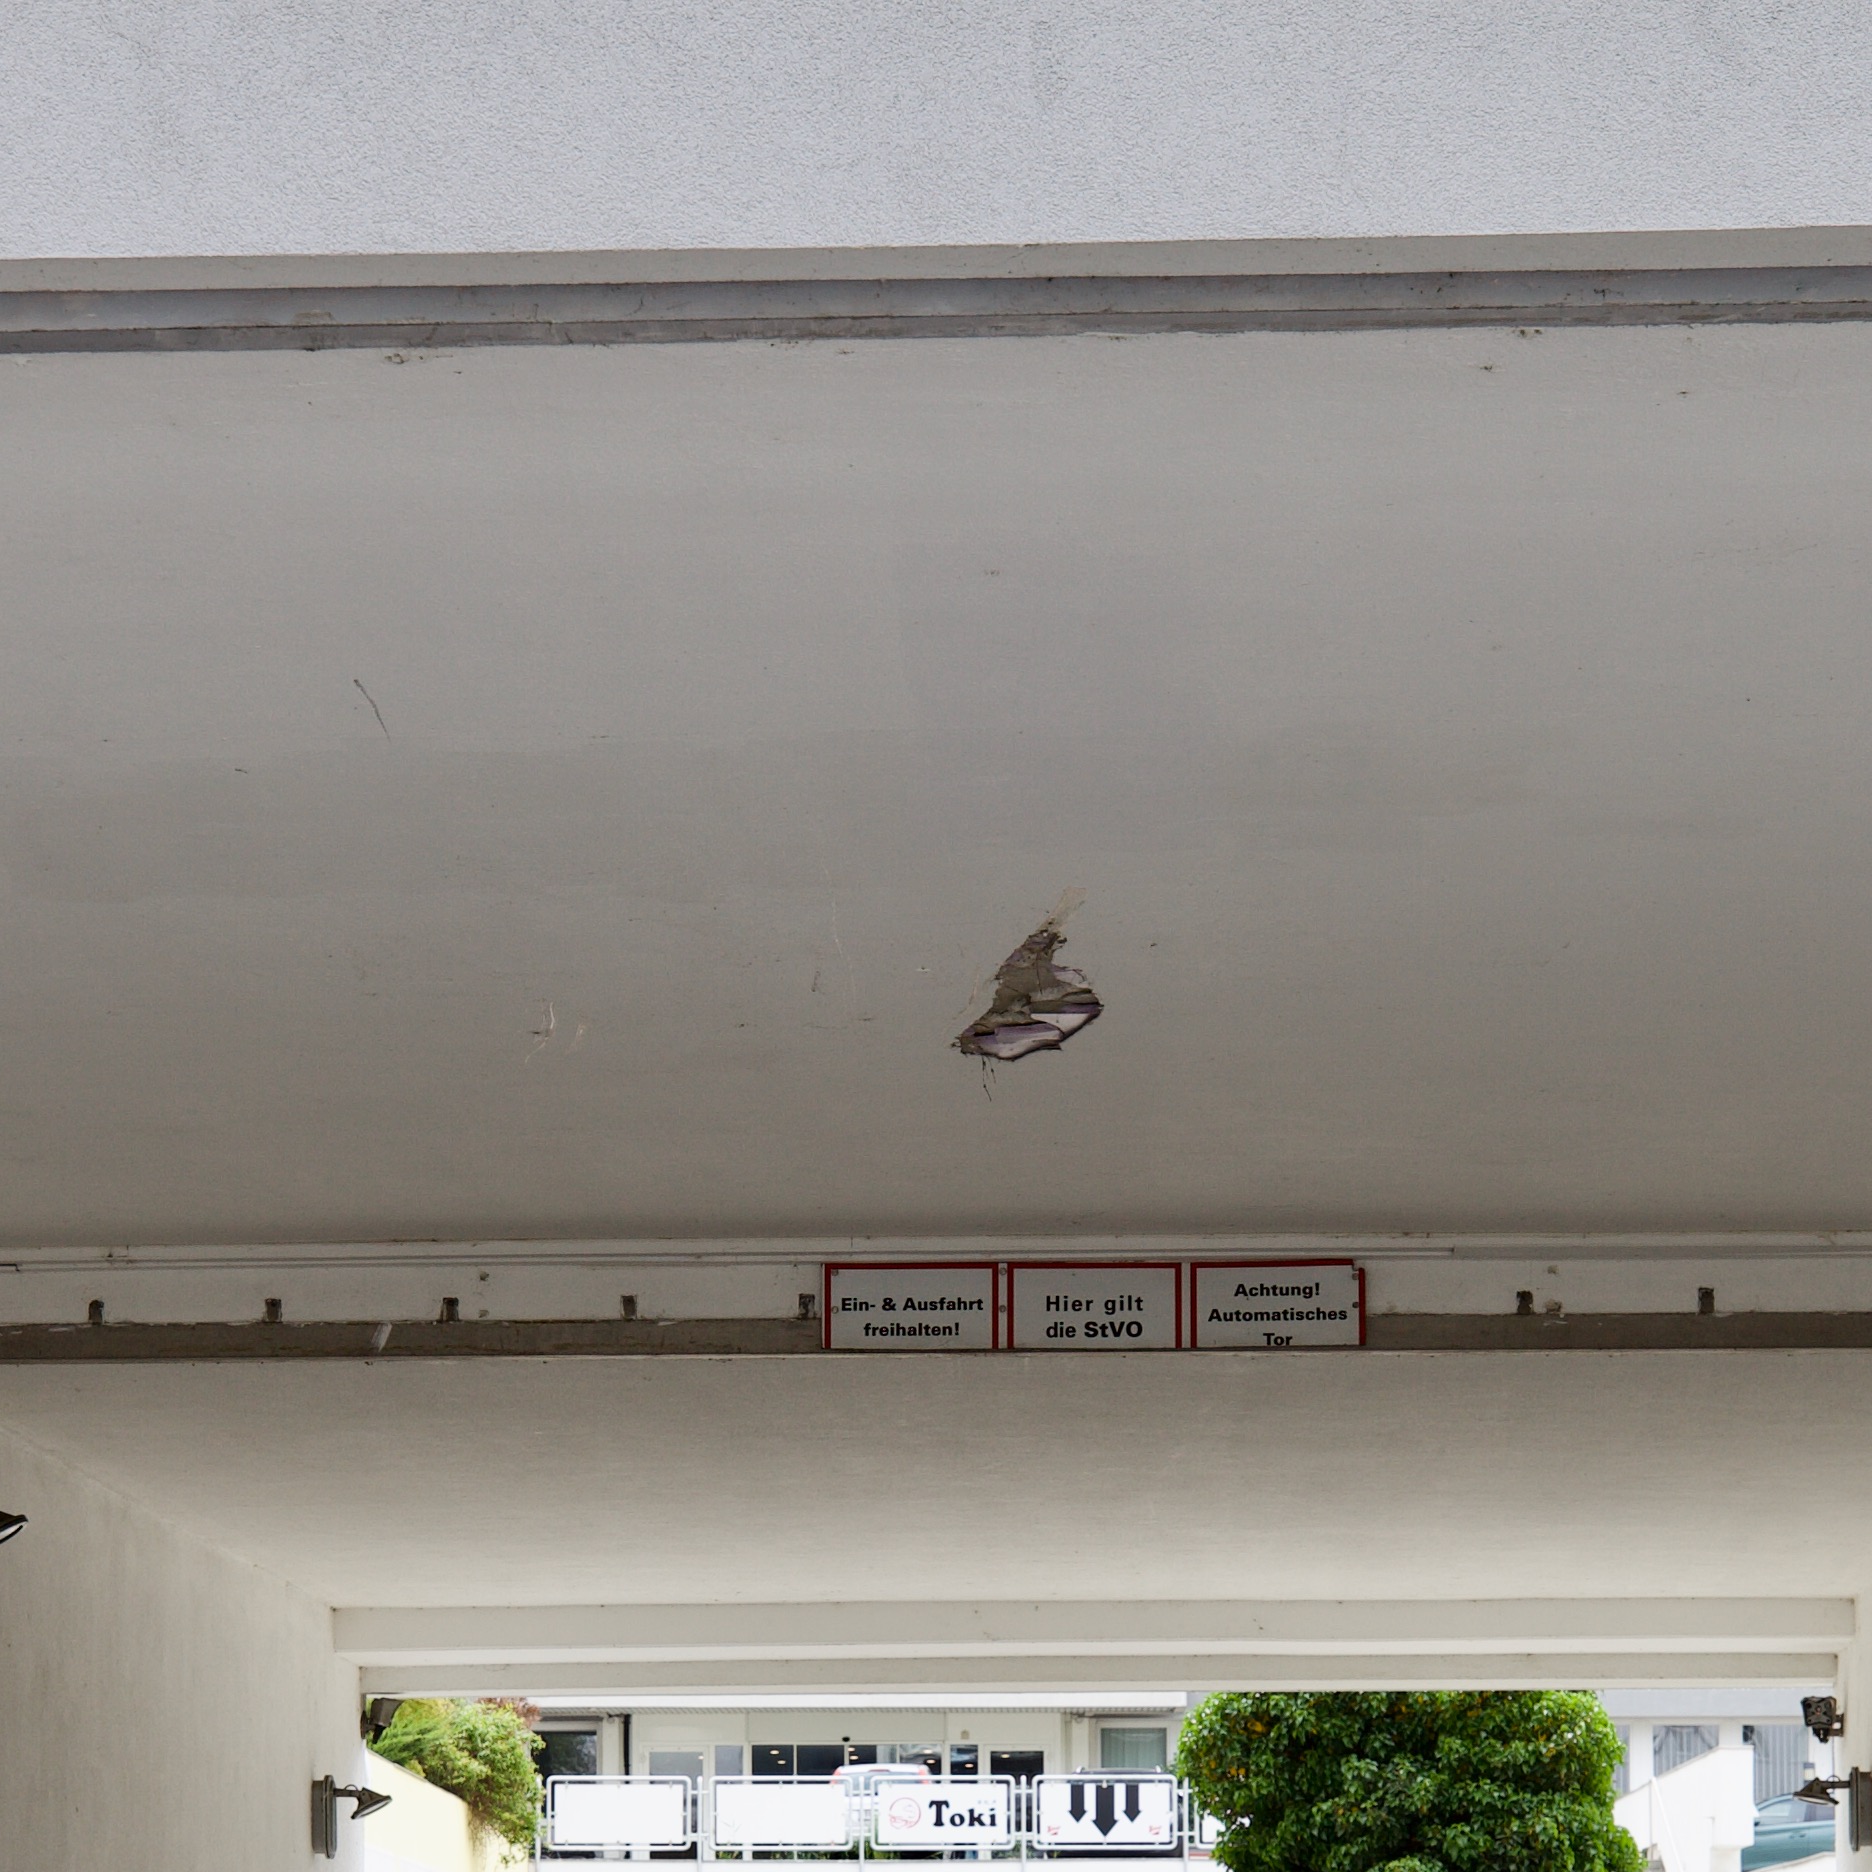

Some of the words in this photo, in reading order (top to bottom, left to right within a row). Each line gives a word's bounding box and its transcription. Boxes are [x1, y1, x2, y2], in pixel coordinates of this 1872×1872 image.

[1234, 1283, 1320, 1299] Achtung!
[841, 1297, 876, 1312] Ein-
[881, 1297, 897, 1312] &
[903, 1297, 984, 1312] Ausfahrt
[1045, 1296, 1094, 1312] Hier
[1103, 1295, 1144, 1315] gilt
[1208, 1307, 1348, 1323] Automatisches
[864, 1322, 960, 1337] freihalten!
[1045, 1322, 1077, 1338] die
[1083, 1321, 1143, 1338] StVO
[1263, 1332, 1293, 1347] Tor
[929, 1800, 997, 1828] Toki
